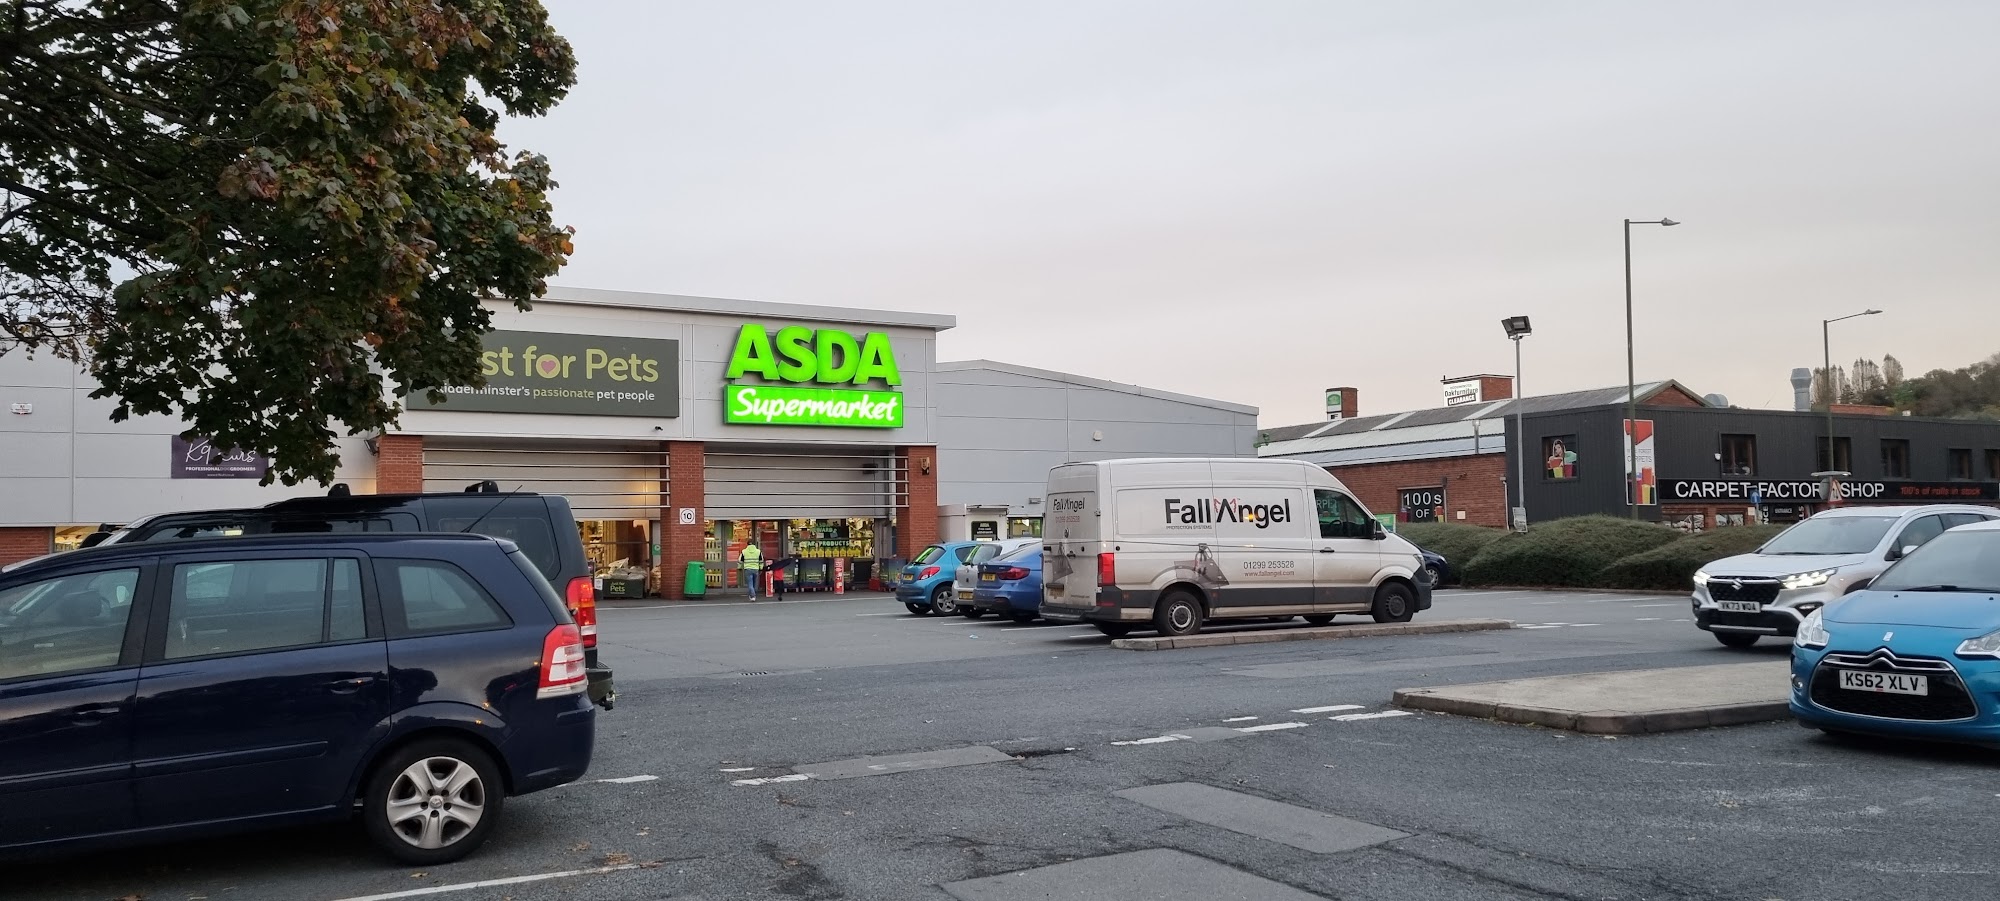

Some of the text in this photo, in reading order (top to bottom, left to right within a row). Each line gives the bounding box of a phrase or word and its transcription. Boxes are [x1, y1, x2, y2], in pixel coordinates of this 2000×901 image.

[725, 323, 902, 386] ASDA
[481, 345, 659, 382] st for Pets
[533, 388, 595, 400] passionate
[596, 391, 616, 402] pet
[617, 391, 655, 403] people
[1449, 394, 1475, 405] CLEARANCE
[733, 388, 898, 422] Supermarket
[185, 439, 212, 464] K9
[1627, 455, 1653, 463] CRPETS
[1675, 481, 1885, 498] CARPET FACTOR SHOP
[1922, 487, 1930, 495] of
[1932, 487, 1949, 495] rolls
[1951, 487, 1959, 495] in
[1961, 487, 1981, 496] stock
[683, 512, 693, 520] 10
[1415, 508, 1430, 519] OF
[1243, 560, 1295, 570] 01299 253528
[1244, 570, 1295, 578] www.fallangel.com
[1845, 672, 1919, 691] KS62 XLV
